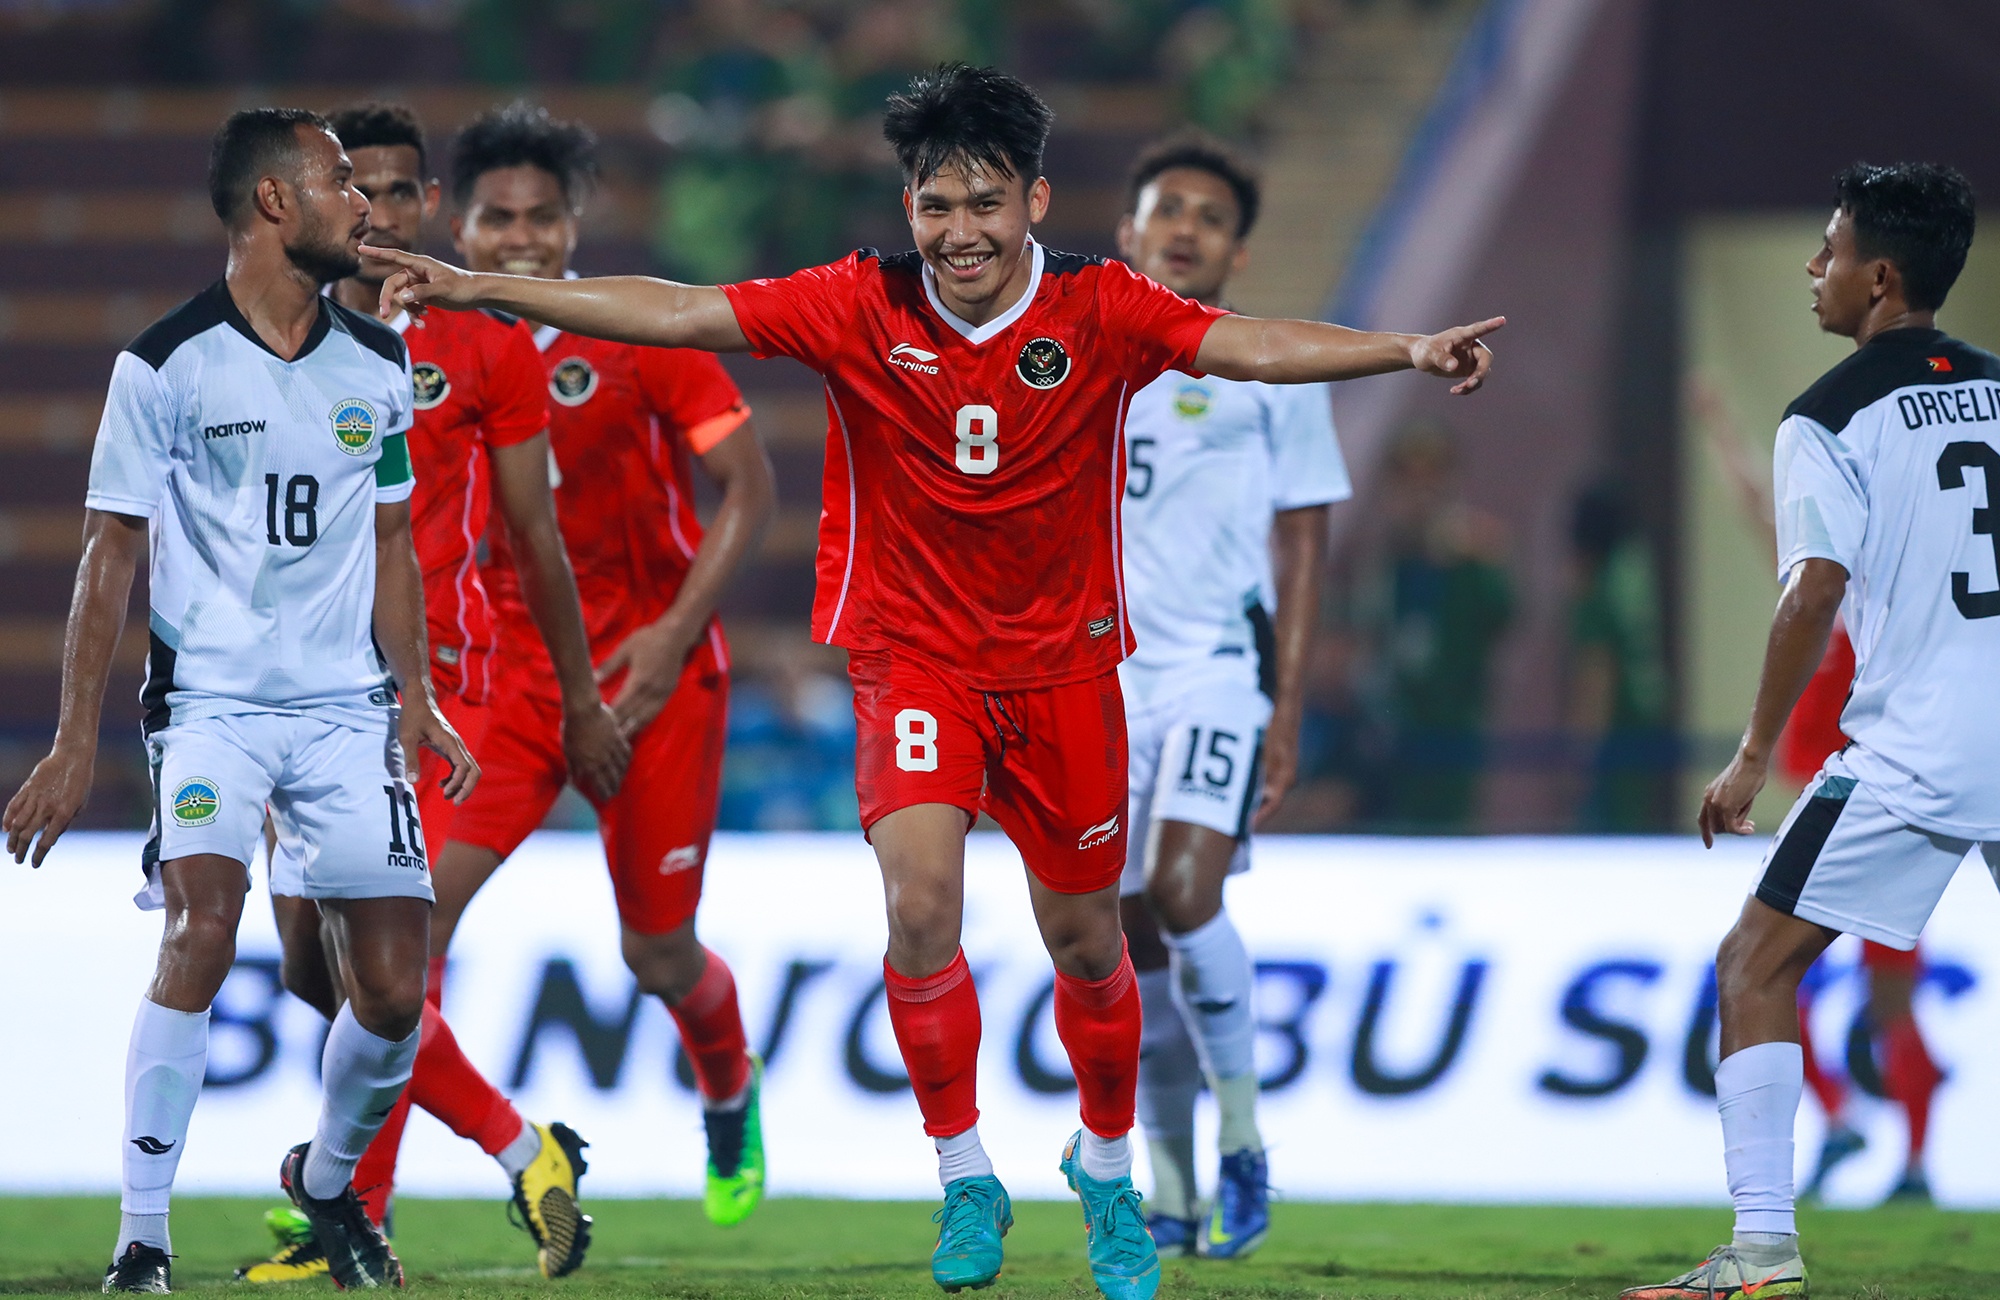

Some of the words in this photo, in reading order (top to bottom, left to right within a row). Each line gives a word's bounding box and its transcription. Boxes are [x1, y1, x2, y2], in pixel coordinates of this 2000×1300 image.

[888, 354, 939, 375] LI-NING
[204, 419, 266, 440] narrow
[344, 434, 366, 443] FFTL
[955, 404, 999, 475] 8
[265, 473, 320, 547] 18
[1936, 440, 2000, 620] 3
[894, 708, 938, 773] 8
[1181, 727, 1238, 788] 15
[184, 808, 206, 817] FFTL
[1078, 823, 1119, 850] LI-NING
[387, 853, 428, 874] narro
